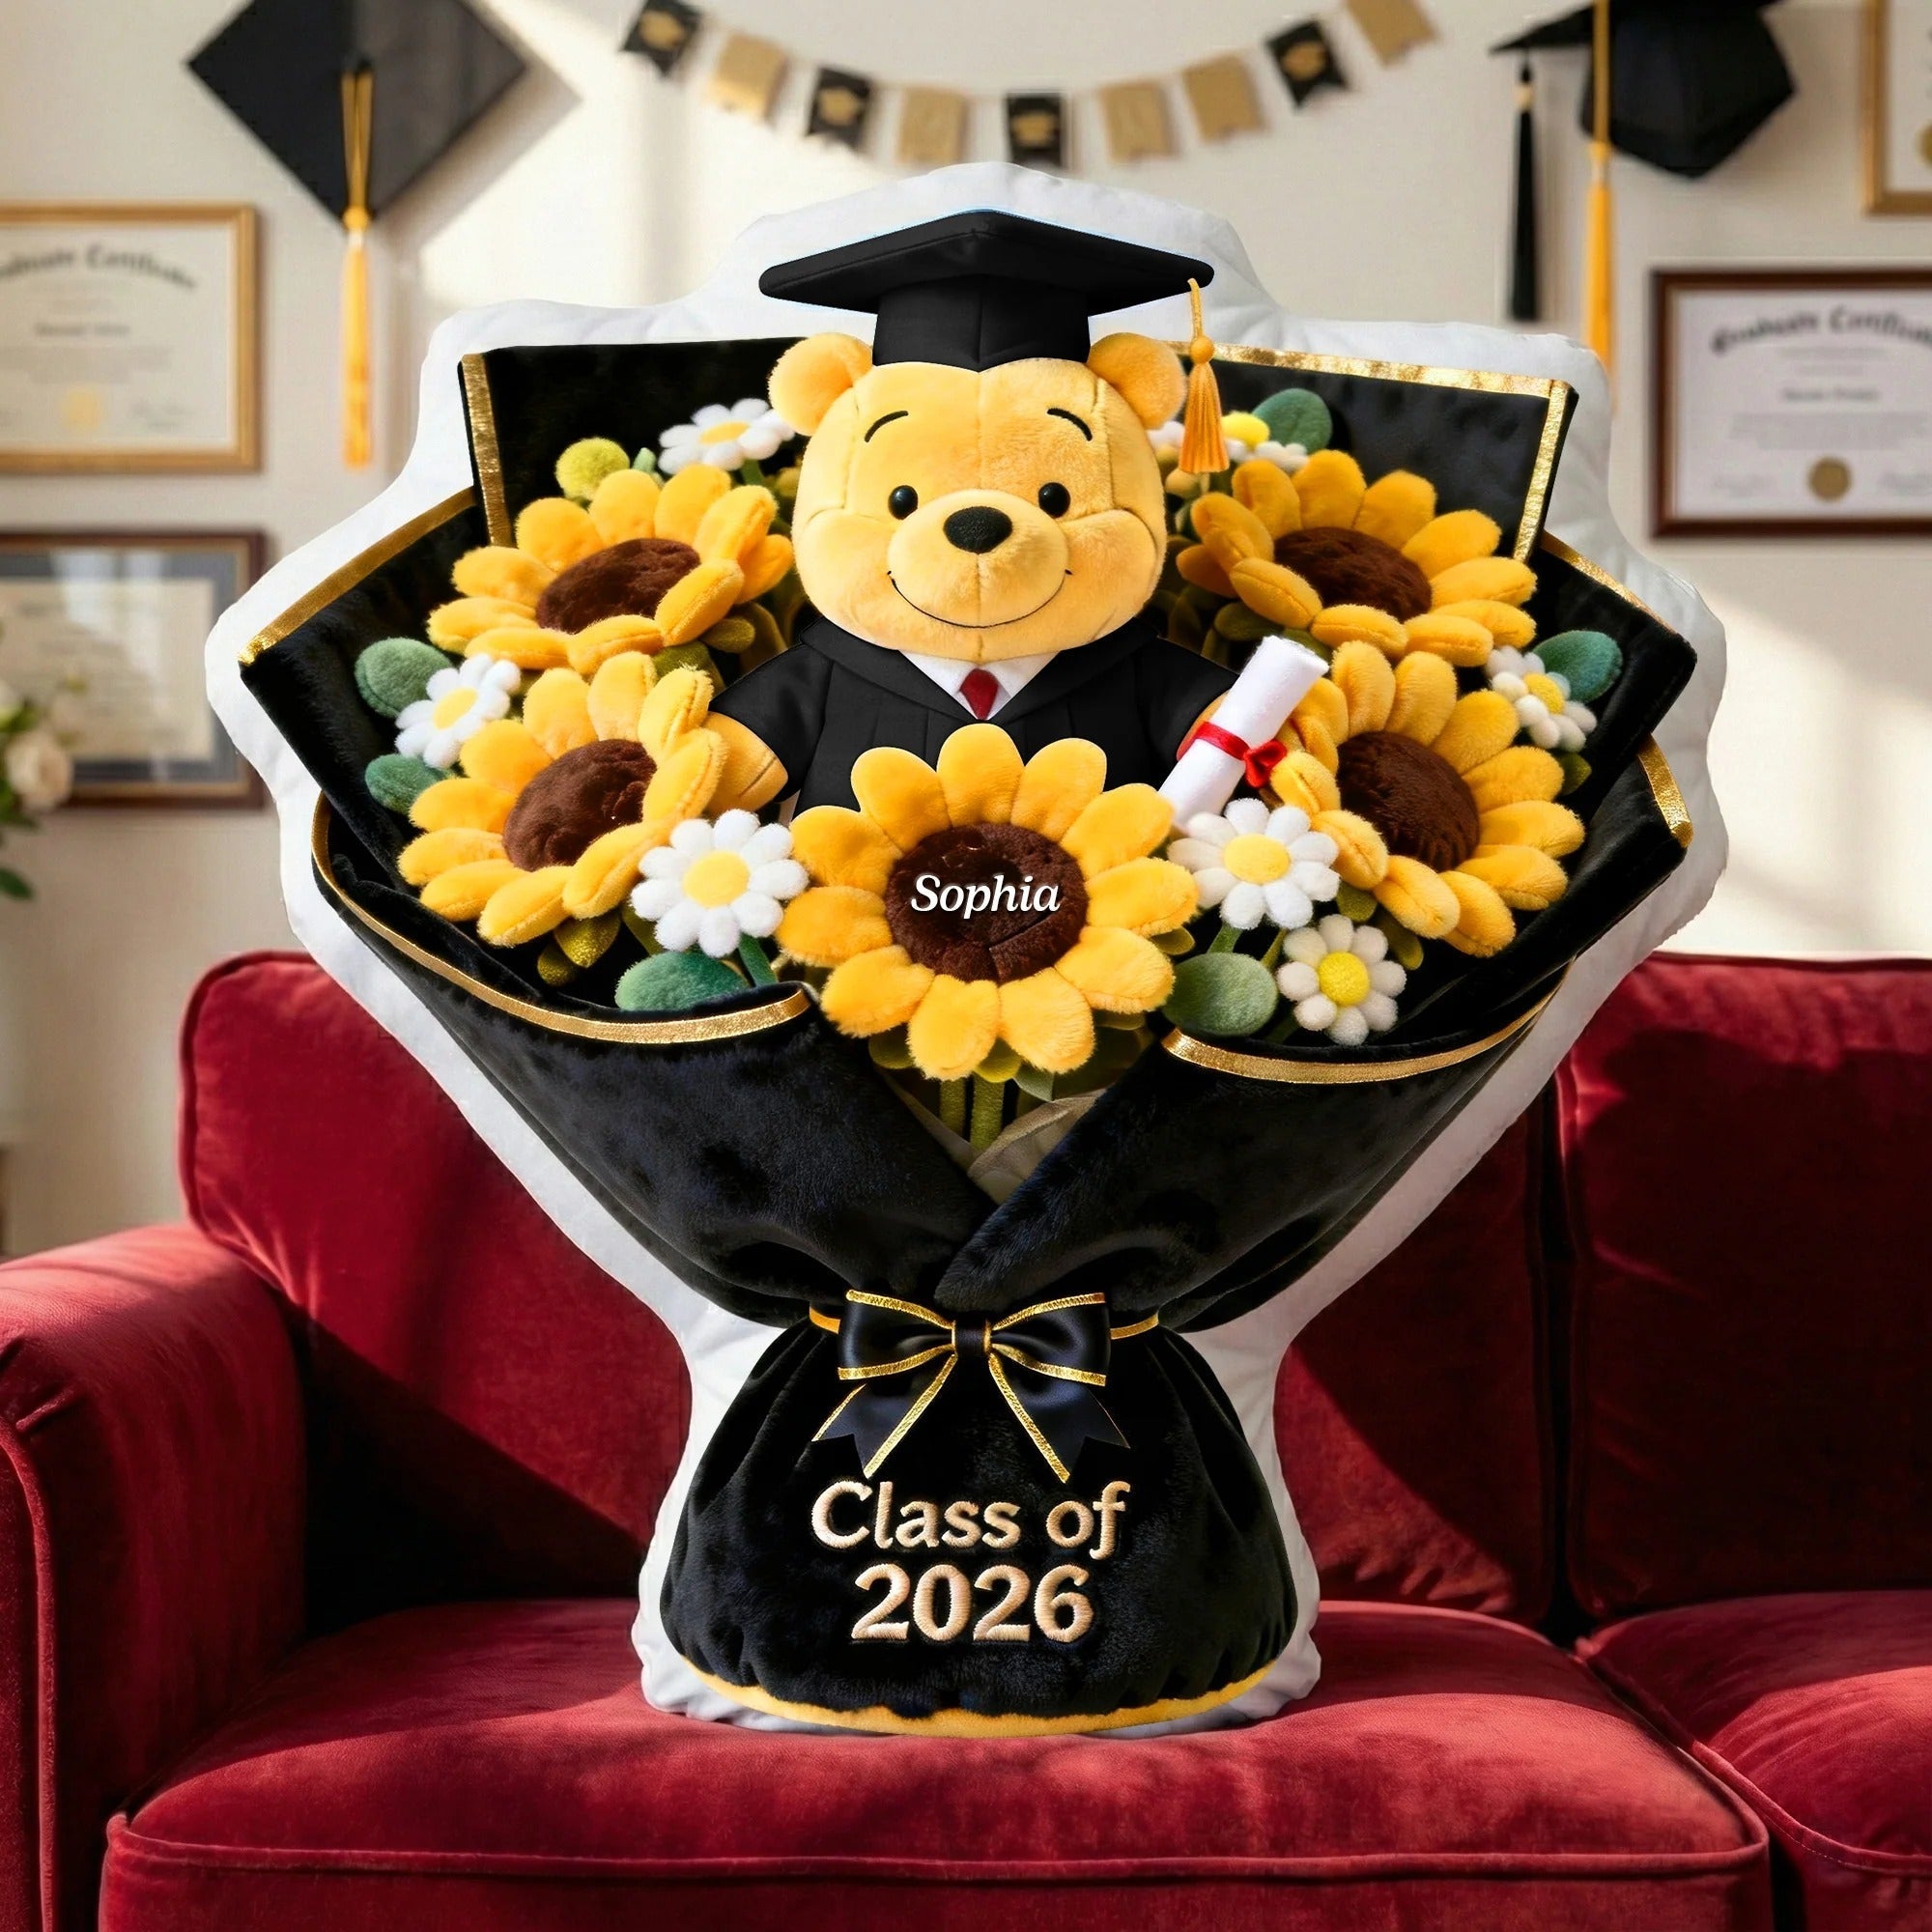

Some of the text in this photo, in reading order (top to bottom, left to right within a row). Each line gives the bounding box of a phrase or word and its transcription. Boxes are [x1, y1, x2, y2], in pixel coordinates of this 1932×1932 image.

[911, 874, 1061, 920] Sophia
[811, 1480, 1131, 1560] Class of
[851, 1563, 1094, 1642] 2026
